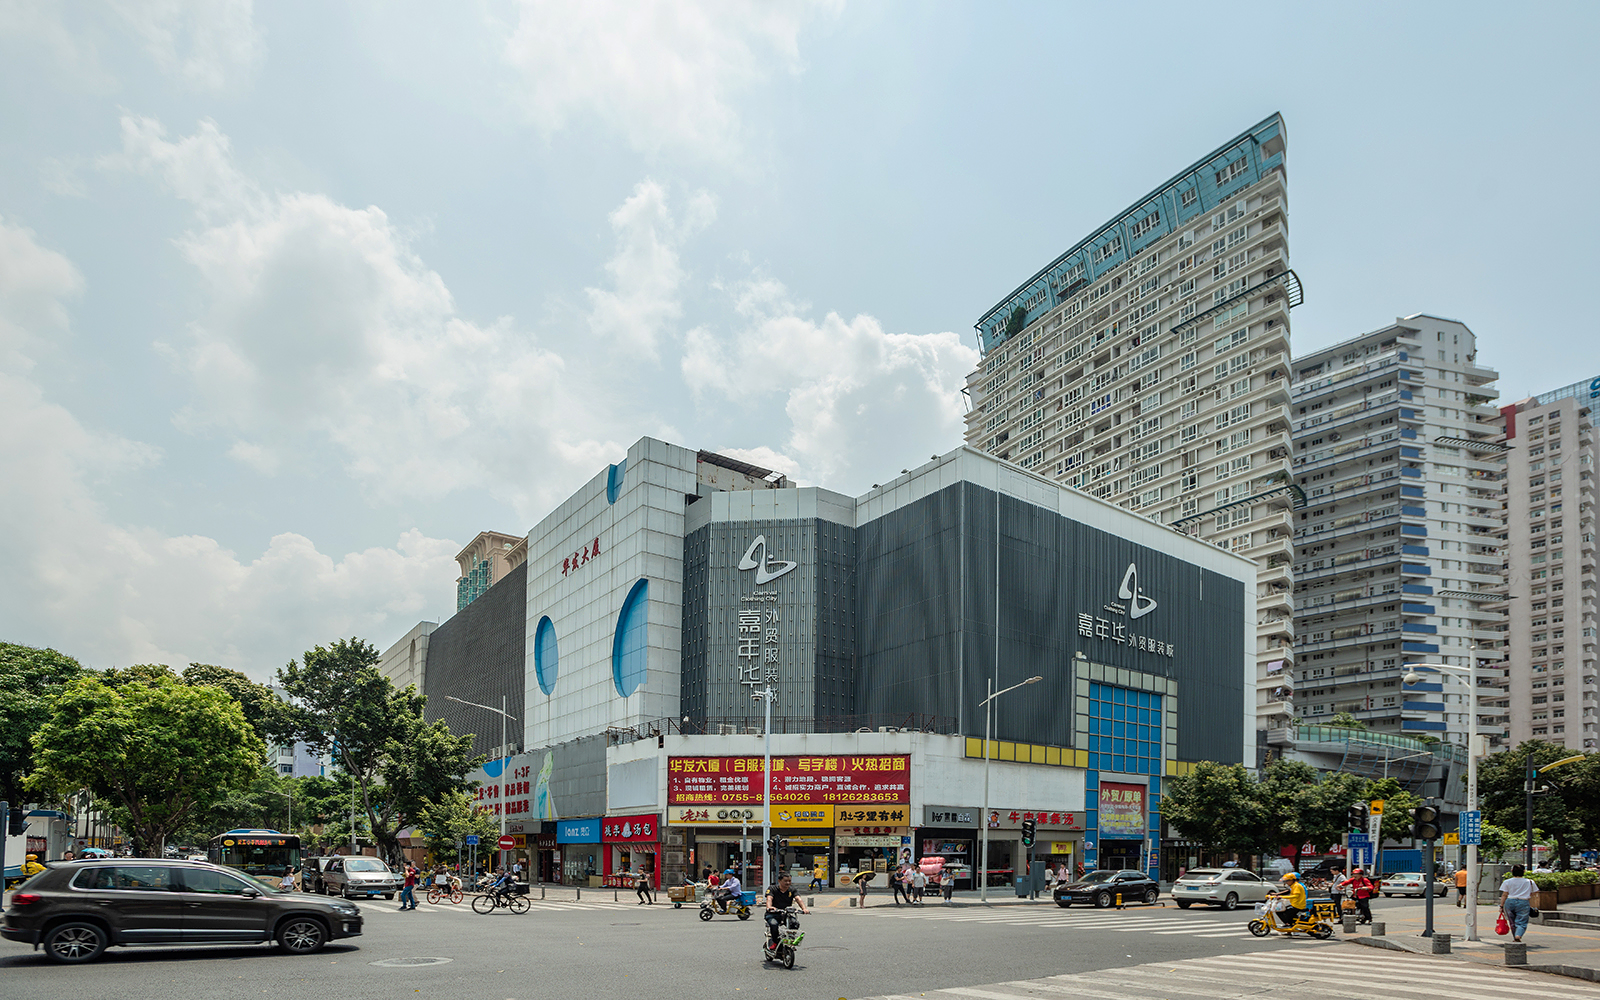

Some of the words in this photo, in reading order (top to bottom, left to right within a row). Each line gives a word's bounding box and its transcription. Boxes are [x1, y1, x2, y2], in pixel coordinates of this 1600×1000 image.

[738, 609, 763, 688] 嘉年华
[1078, 612, 1126, 645] 嘉年华
[1128, 633, 1174, 658] 外贸服装城
[722, 793, 811, 802] 0755-8564026
[823, 793, 899, 802] 18126283653
